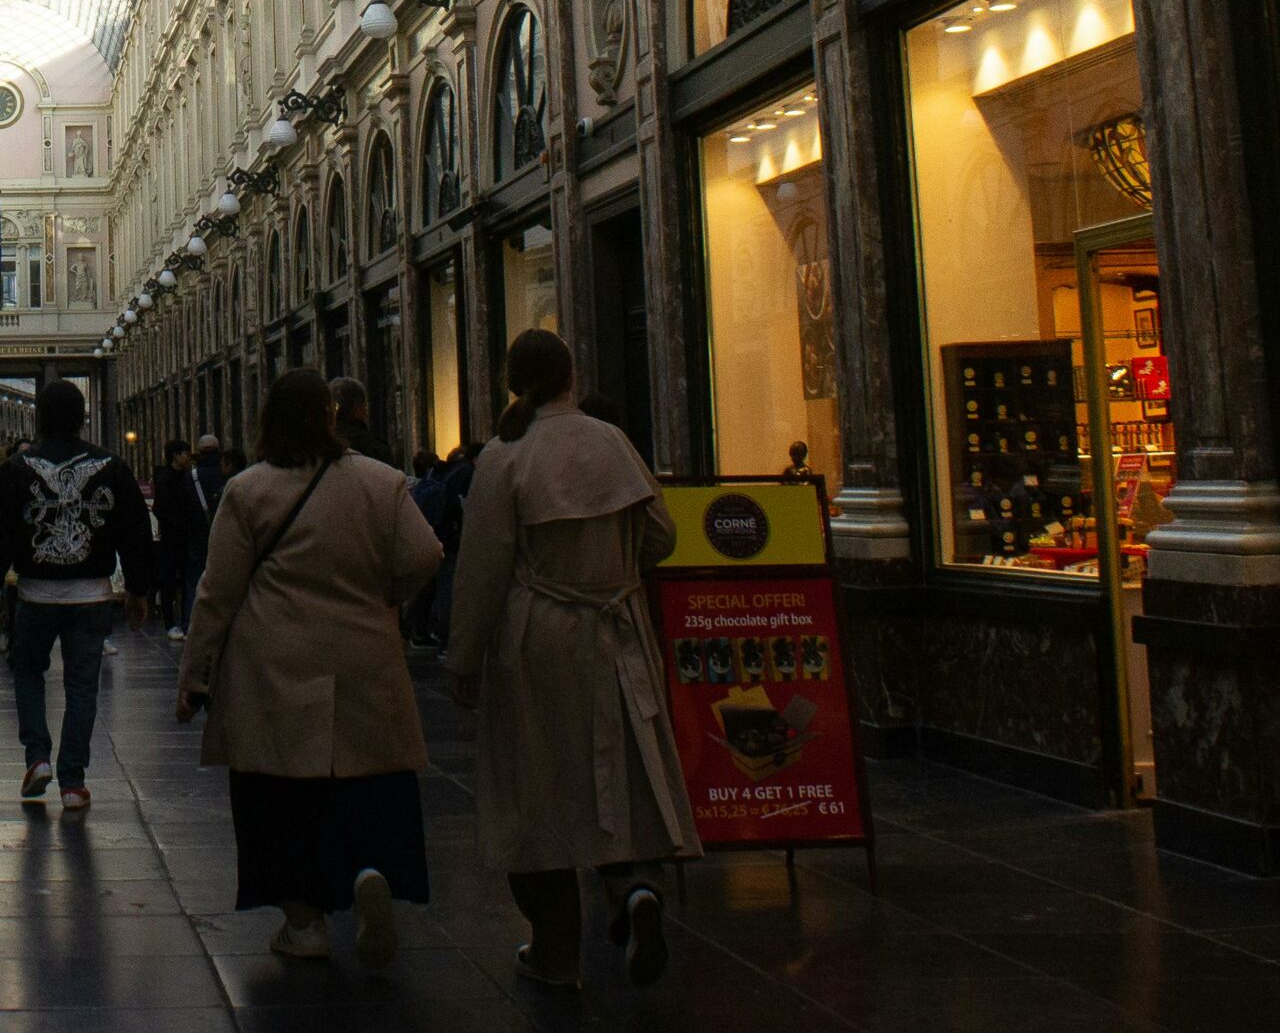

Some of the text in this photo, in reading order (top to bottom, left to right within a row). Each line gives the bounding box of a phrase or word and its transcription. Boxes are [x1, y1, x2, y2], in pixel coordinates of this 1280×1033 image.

[7, 346, 18, 355] LA
[19, 346, 42, 354] REINE
[714, 516, 756, 529] CORNÉ
[687, 593, 806, 610] SPECIAL OFFER!
[684, 612, 813, 630] 235g chocolate gift box
[708, 784, 834, 801] BUY 4 GET 1 FREE
[695, 804, 748, 819] 5x15,25
